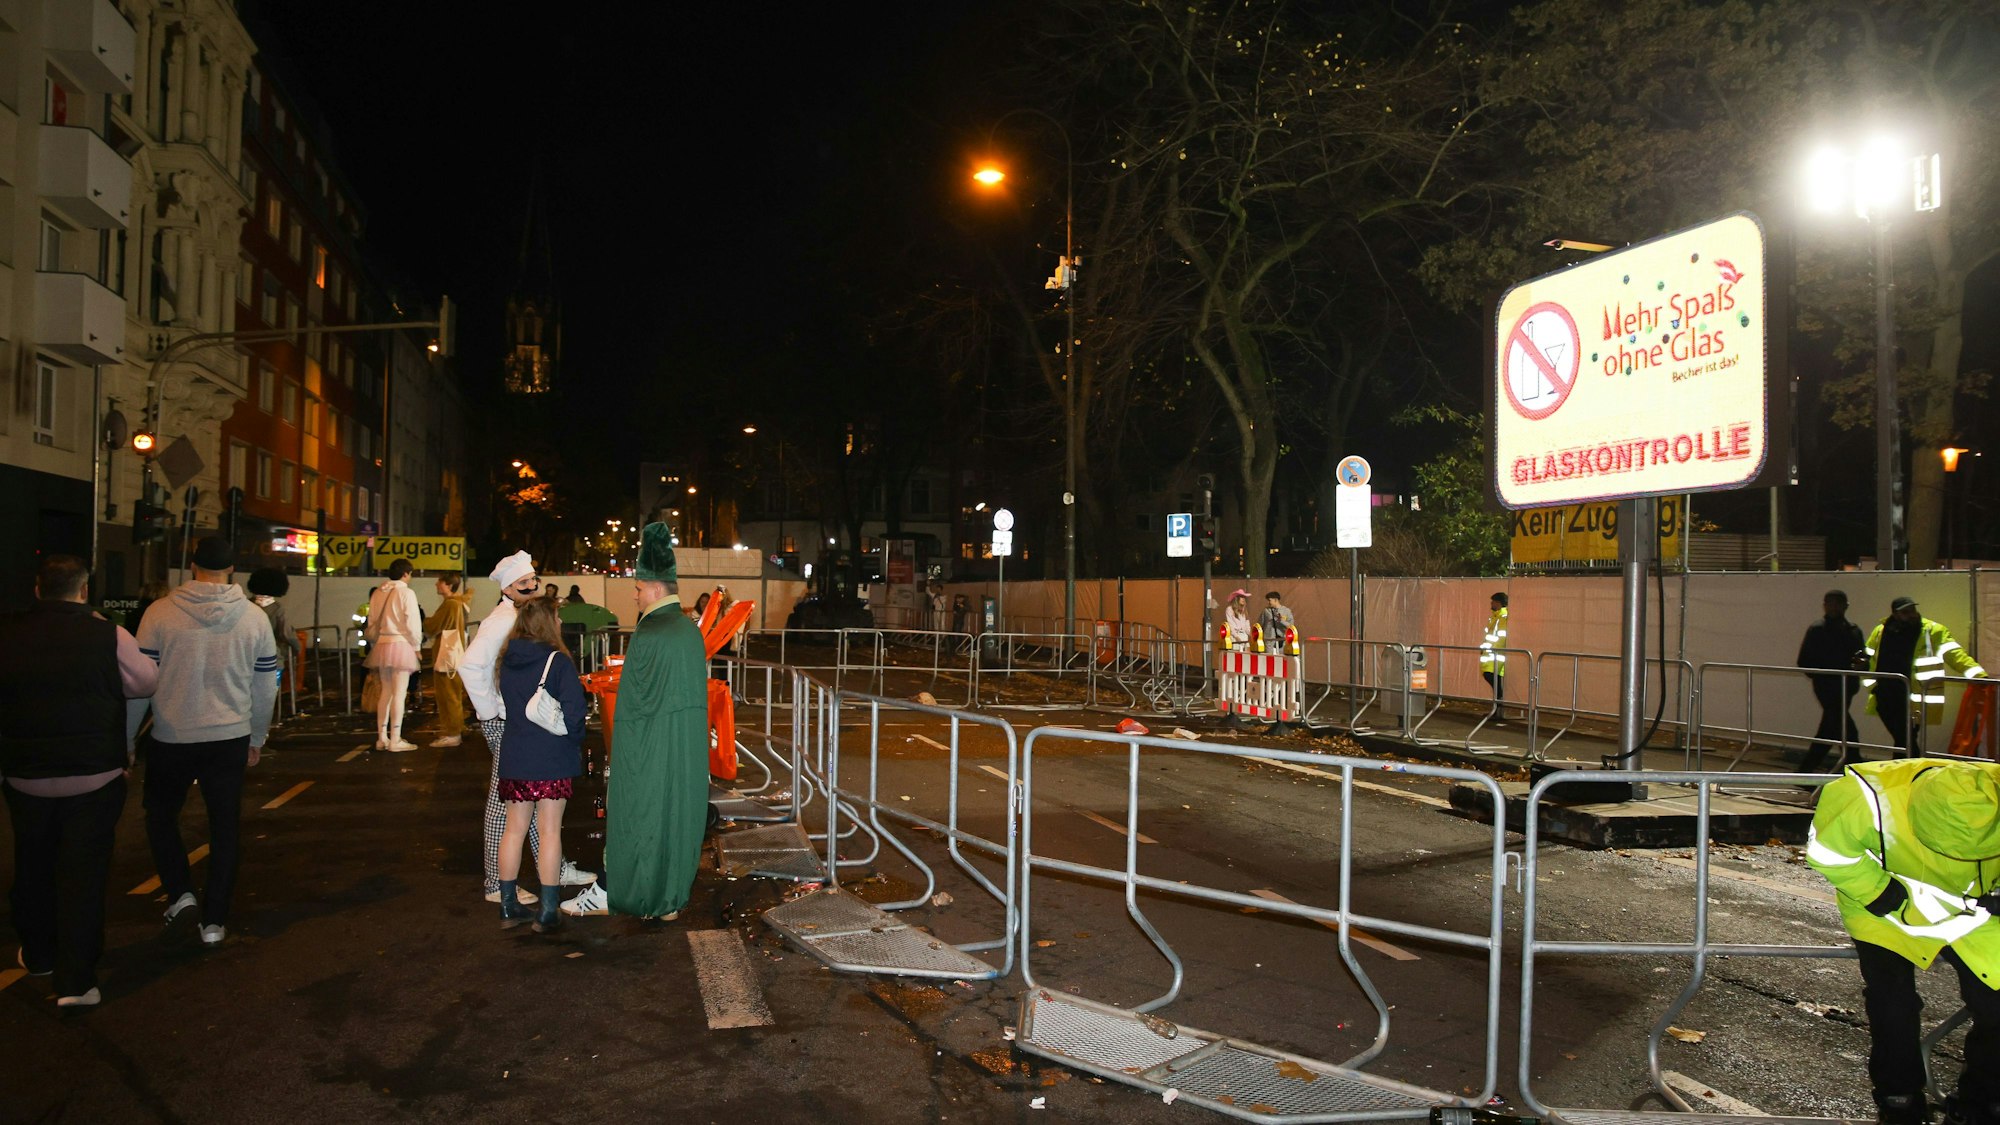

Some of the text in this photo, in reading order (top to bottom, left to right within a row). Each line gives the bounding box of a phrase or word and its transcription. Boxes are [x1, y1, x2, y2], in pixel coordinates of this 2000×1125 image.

[1603, 283, 1736, 341] Mehr Spaß
[1604, 327, 1725, 376] ohne Glas
[1672, 353, 1740, 383] Becher ist das!
[1512, 423, 1752, 485] GLASKONTROLLE
[1172, 517, 1186, 537] P
[1512, 500, 1676, 540] Kein Zugg
[322, 537, 367, 556] Kein
[376, 537, 462, 560] Zugang
